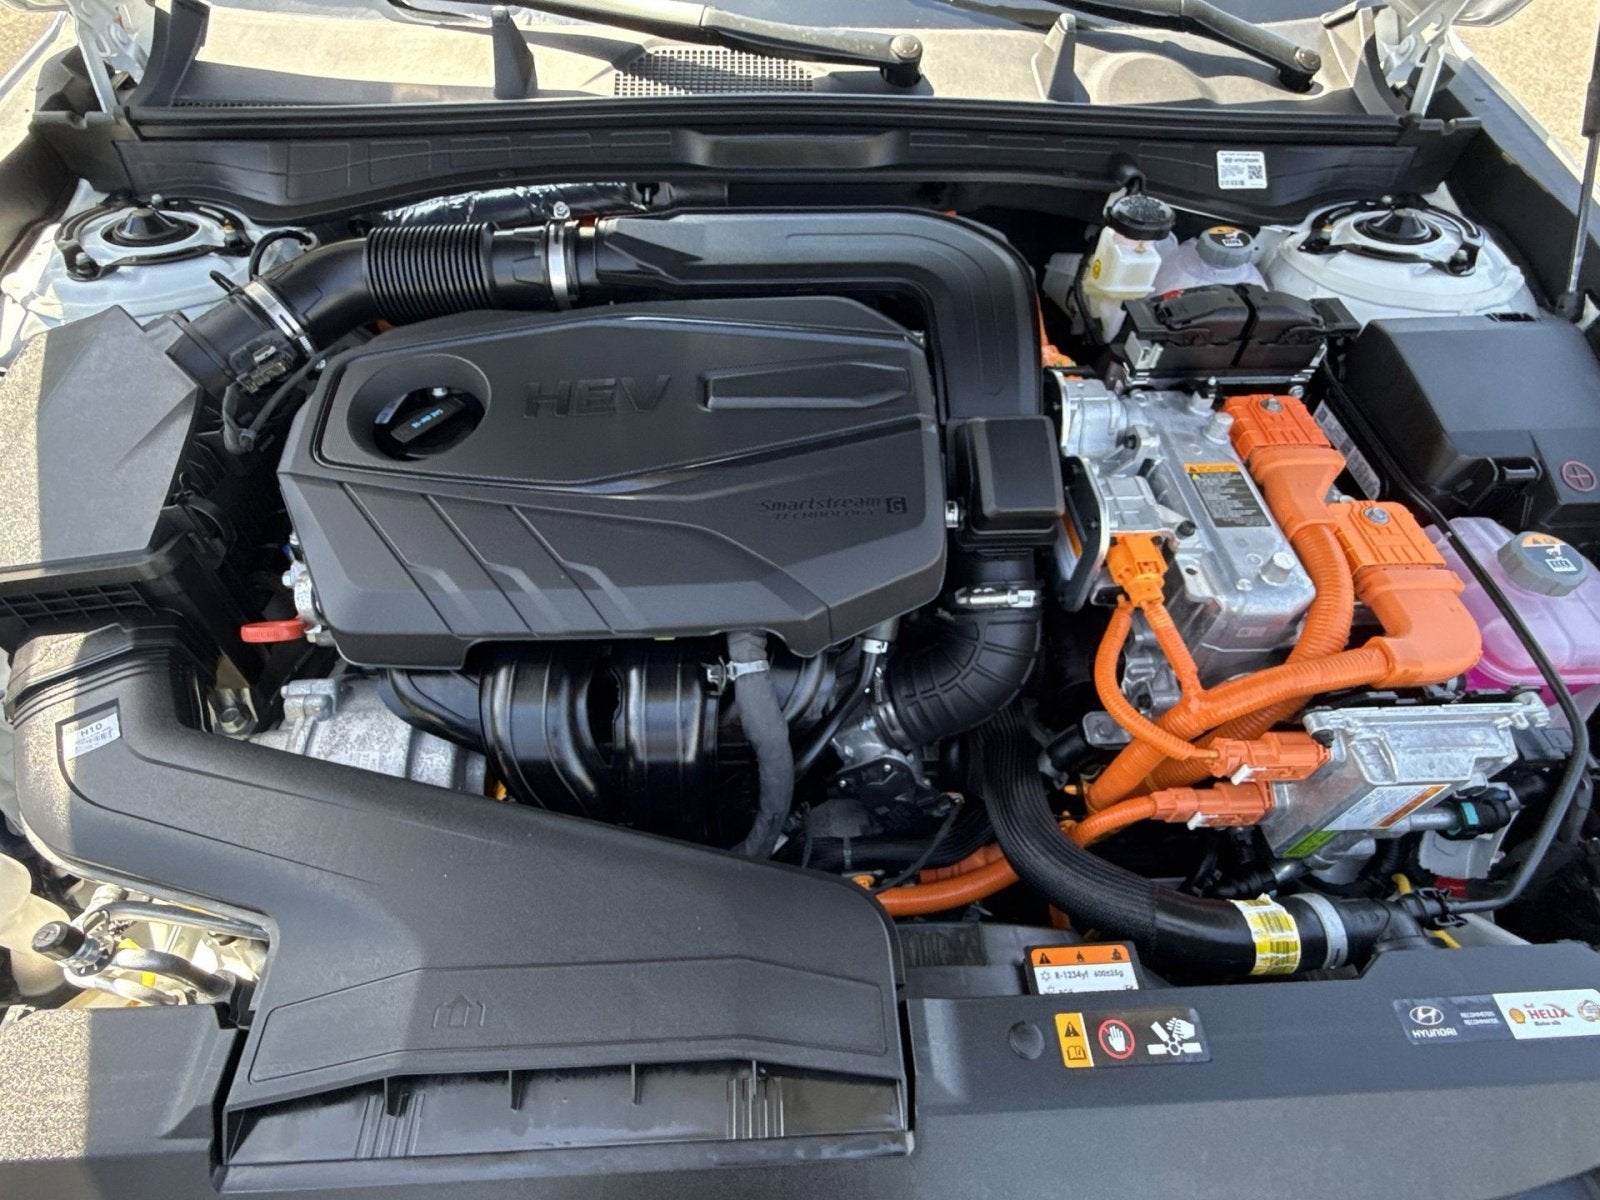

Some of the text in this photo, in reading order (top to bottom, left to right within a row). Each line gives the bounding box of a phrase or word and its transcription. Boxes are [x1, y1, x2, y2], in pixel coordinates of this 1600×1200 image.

[523, 374, 671, 418] HEV
[760, 496, 880, 511] Smartstream
[81, 723, 103, 737] H10
[1055, 970, 1089, 979] R-1234yf
[1527, 1008, 1569, 1019] HELIX
[1412, 1027, 1458, 1038] HYUNDAI
